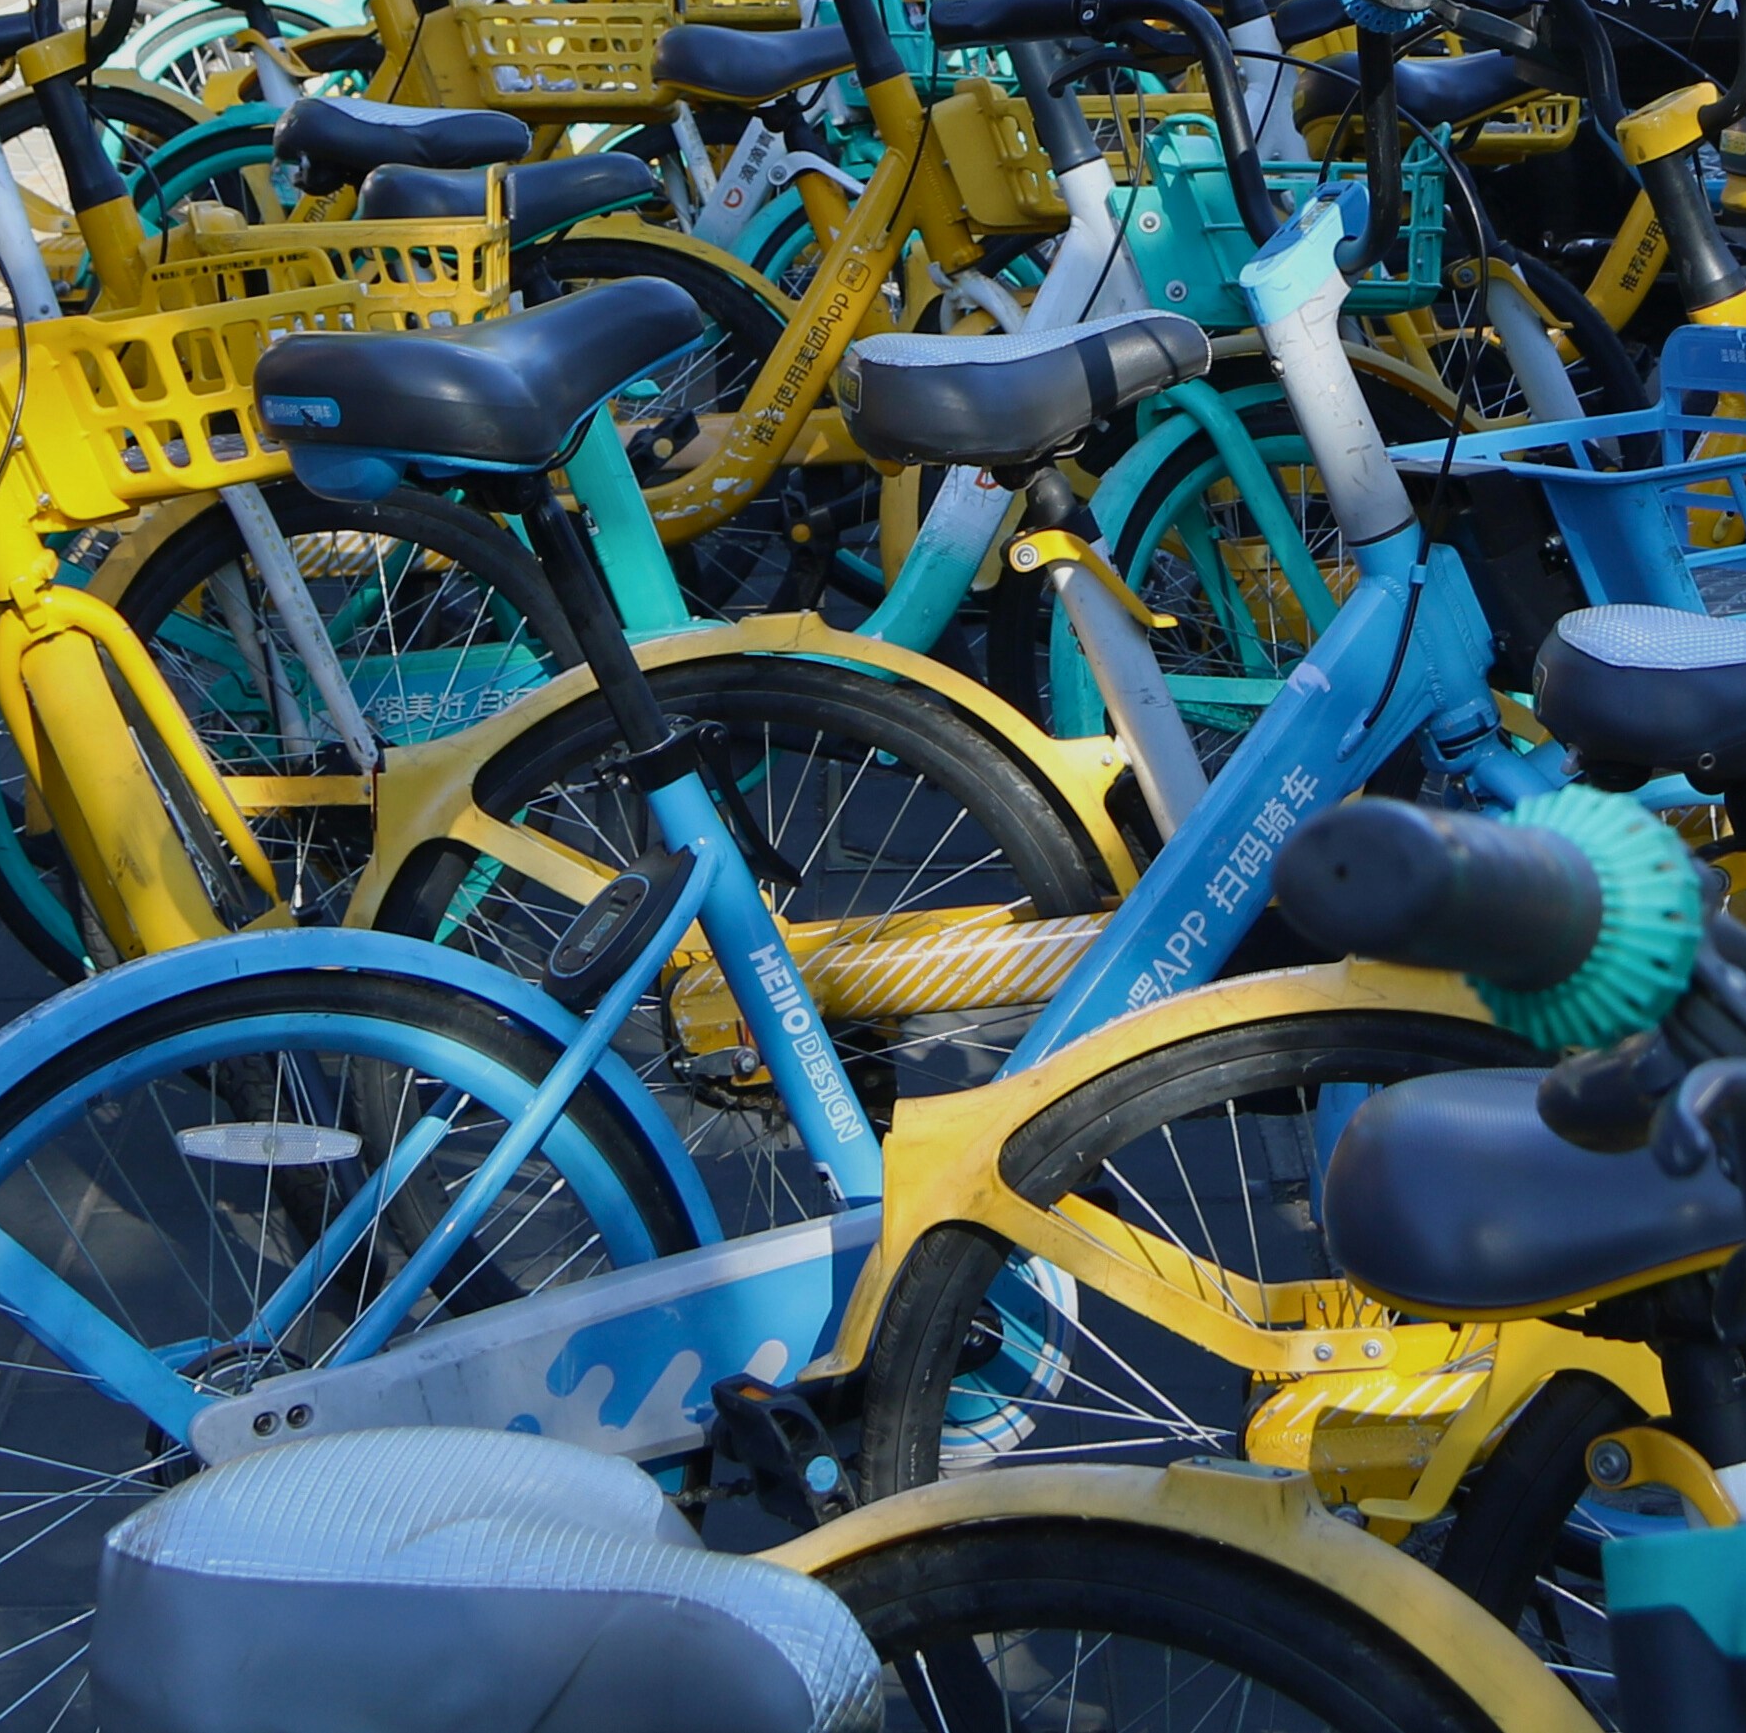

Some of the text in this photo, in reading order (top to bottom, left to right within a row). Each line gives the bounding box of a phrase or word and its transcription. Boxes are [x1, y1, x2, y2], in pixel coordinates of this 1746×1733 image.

[1205, 765, 1319, 915] 扫码骑车
[791, 1030, 864, 1144] DESIGN
